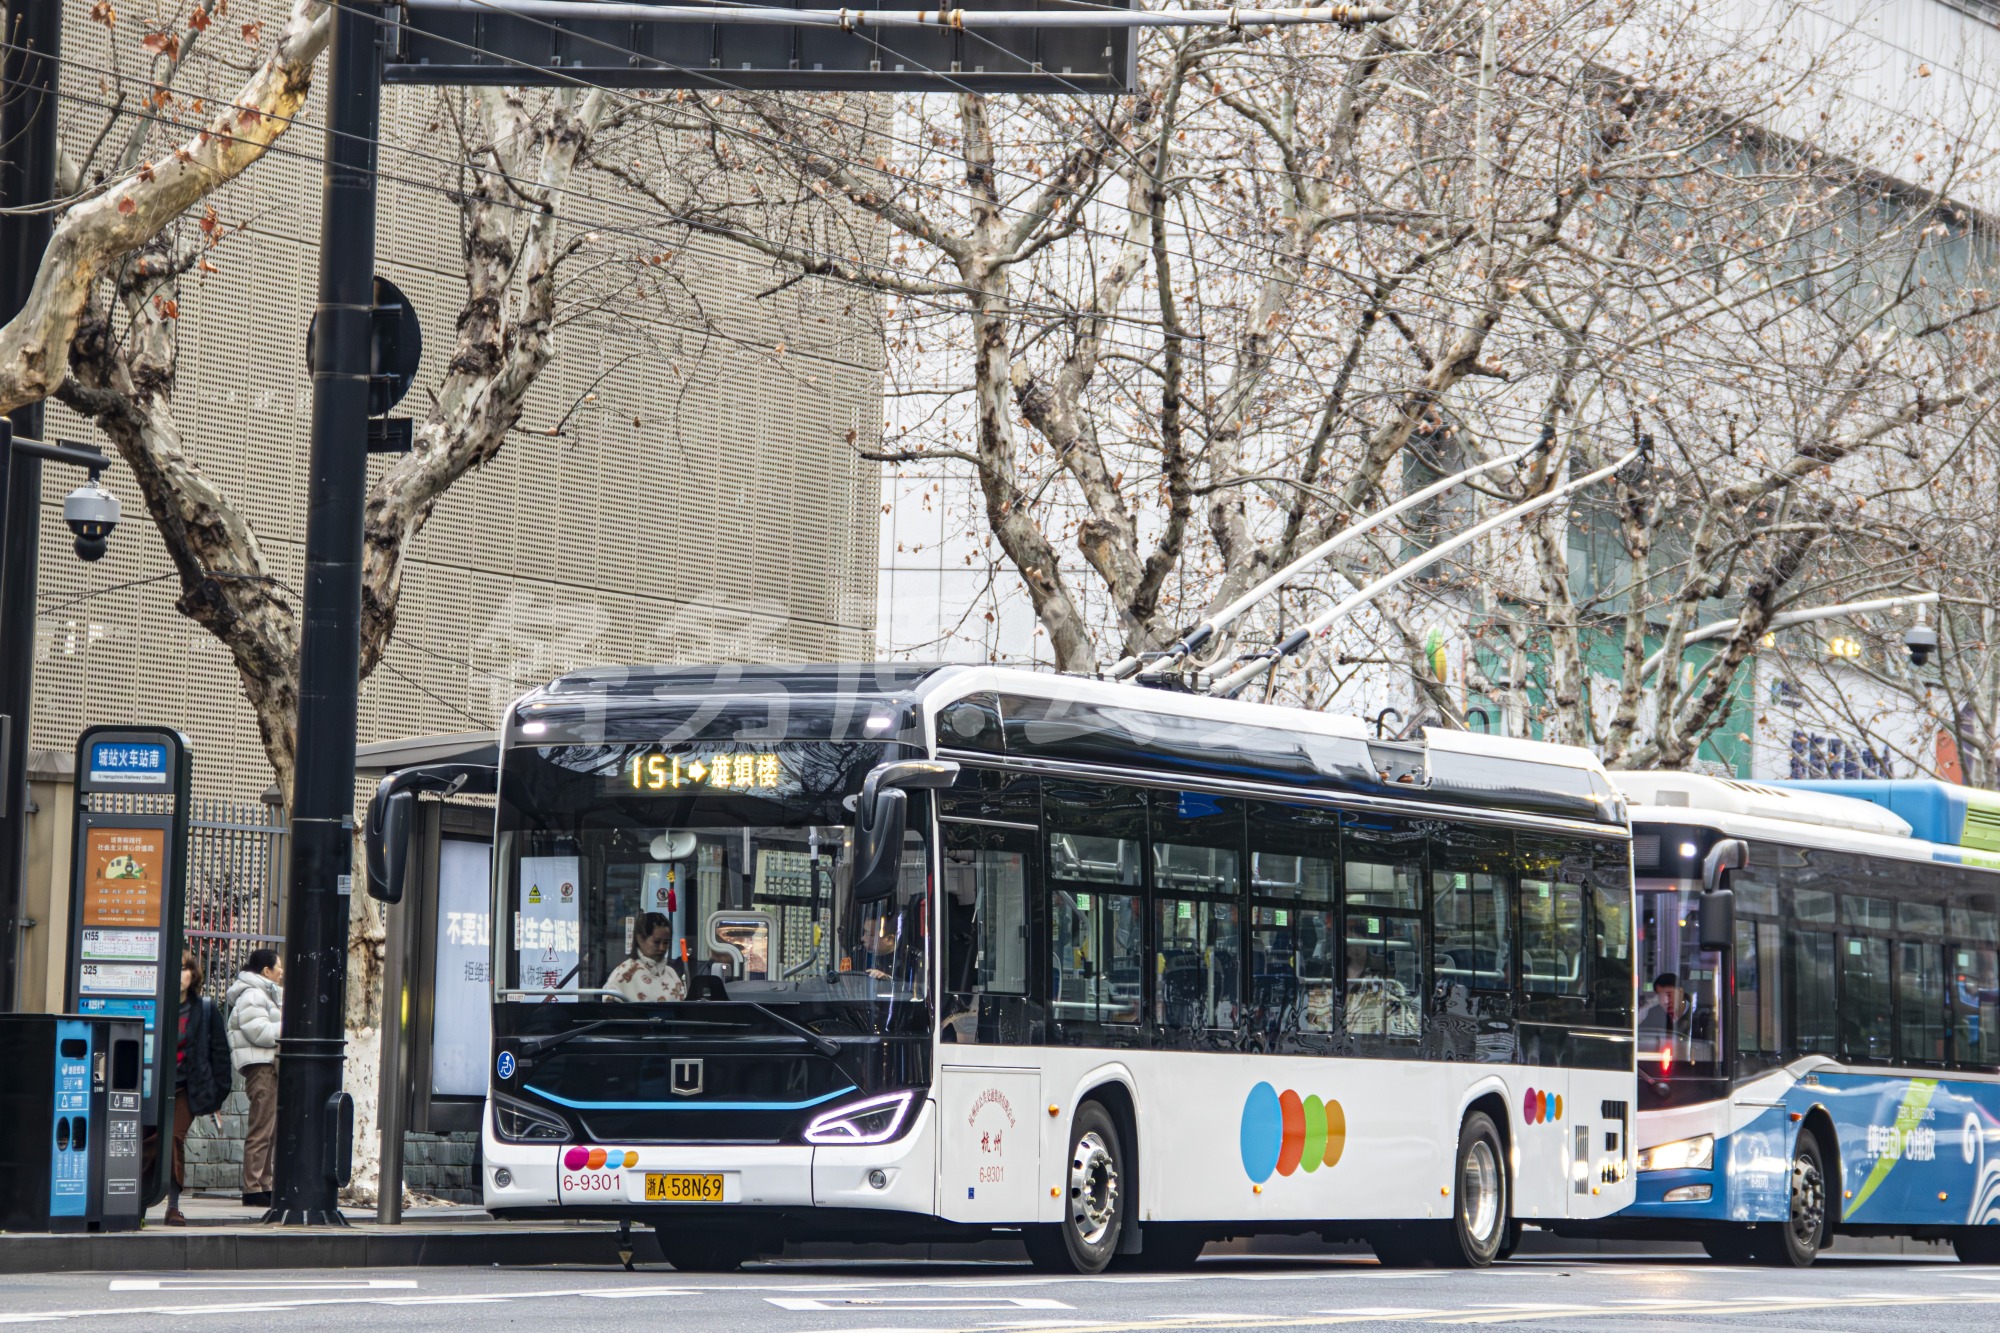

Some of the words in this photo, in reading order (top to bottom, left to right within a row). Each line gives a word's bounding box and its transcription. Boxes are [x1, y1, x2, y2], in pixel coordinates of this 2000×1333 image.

[98, 748, 160, 768] 城站火车站南
[632, 755, 682, 789] 151
[710, 754, 778, 788] 雄镇楼
[84, 931, 99, 941] K155
[83, 965, 98, 975] 325
[563, 1174, 621, 1191] 6-9301
[979, 1166, 1004, 1183] 6-9301
